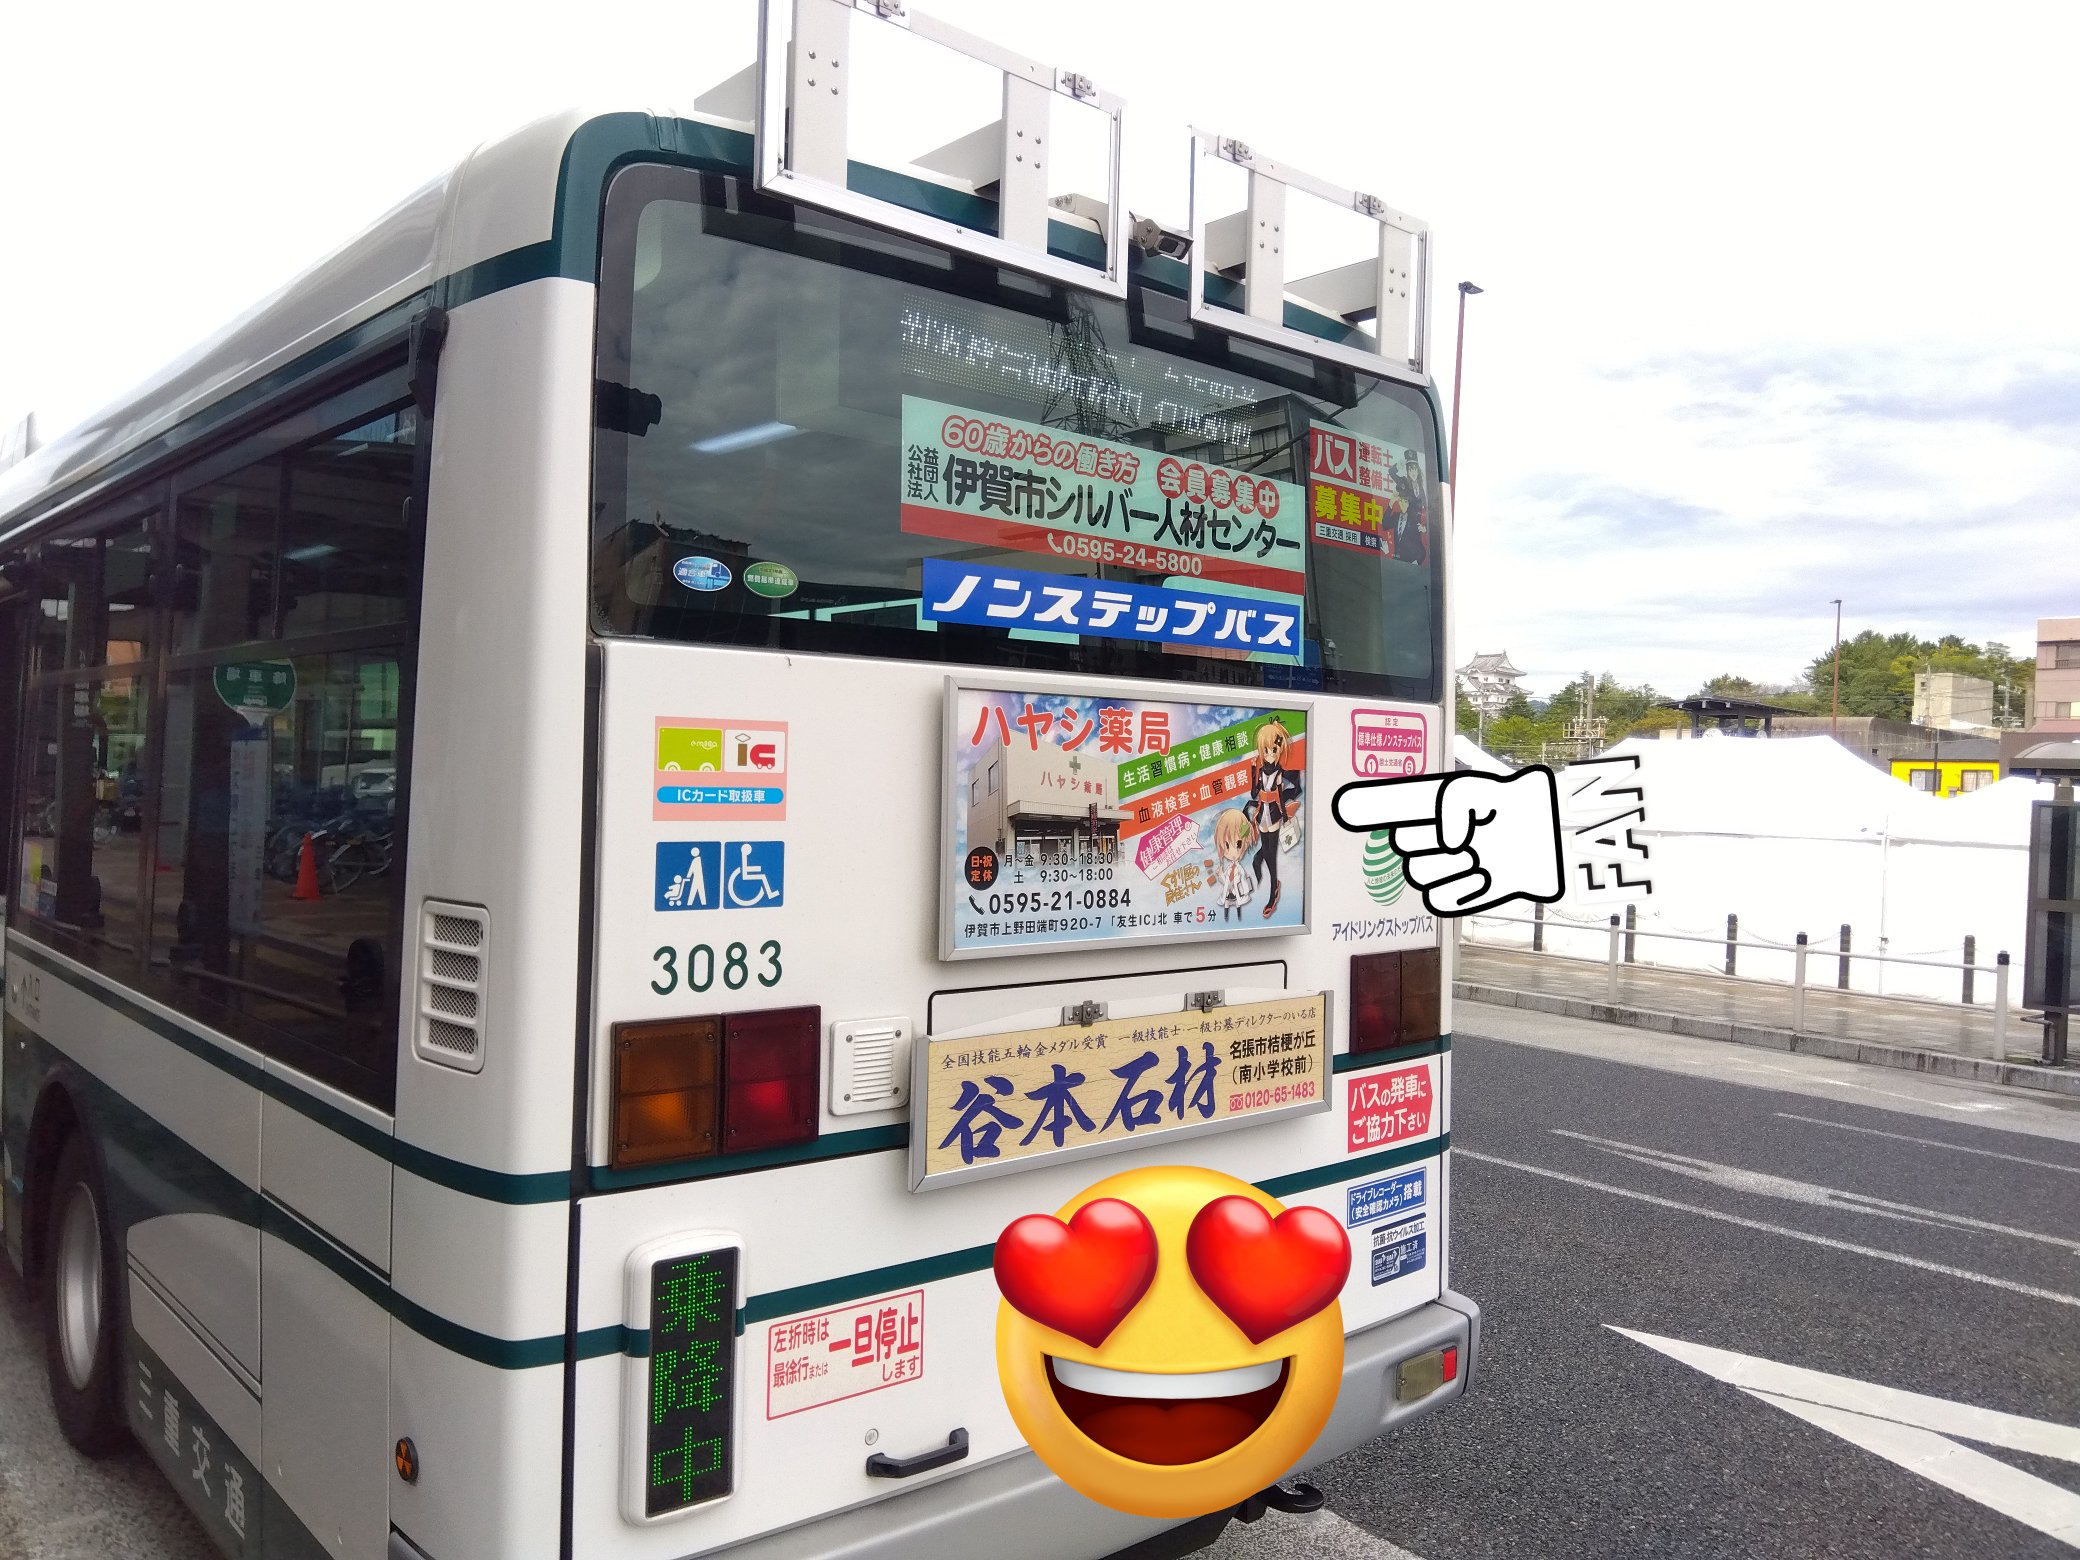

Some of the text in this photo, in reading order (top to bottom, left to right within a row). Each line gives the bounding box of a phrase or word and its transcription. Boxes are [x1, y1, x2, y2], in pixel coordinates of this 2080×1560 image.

[907, 444, 939, 467] 公益
[942, 415, 1140, 485] 60歳からの働き方
[1314, 434, 1353, 479] バス
[1359, 441, 1394, 468] 運転士
[907, 461, 939, 484] 社団
[1160, 461, 1277, 516] 会員募集中
[1359, 466, 1394, 493] 整備士
[907, 479, 939, 503] 法人
[942, 453, 1301, 559] 伊賀市シルバー人材センター
[1314, 485, 1384, 531] 募集中
[1063, 533, 1203, 576] 0595-24-5800
[931, 573, 1296, 648] ノンステップバス
[970, 702, 1171, 756] ハヤシ薬局
[1358, 731, 1422, 748] 標準仕様ノンステップバス
[1122, 731, 1249, 789] 生活習慣病・健康相談
[677, 789, 765, 803] ICカード取扱車
[1138, 769, 1249, 824] 血液検査・血管観察
[970, 870, 993, 882] 定休
[1013, 871, 1025, 884] 土
[988, 888, 1131, 915] 0595-21-0884
[964, 916, 1102, 938] 伊賀市上野田端町920-7
[1173, 906, 1217, 924] 車で5分
[1332, 915, 1433, 942] アイドリングストップバス
[650, 939, 784, 996] 3083
[941, 1033, 1108, 1069] 全国技能五輪金メダル受賞
[1229, 1029, 1316, 1060] 名張市桔梗が丘
[937, 1041, 1222, 1165] 谷本石材
[1244, 1080, 1315, 1109] 0120-65-1483
[1351, 1073, 1427, 1112] バスの発車に
[1352, 1110, 1426, 1145] ご協力下さい
[1350, 1180, 1423, 1206] ドライブレコーダー 搭載
[773, 1317, 830, 1353] 左折時は
[828, 1302, 920, 1368] 一旦停止
[652, 1254, 726, 1502] 乗降中
[772, 1356, 829, 1388] 最徐行または
[881, 1355, 920, 1382] します
[138, 1359, 245, 1540] 三重交通
